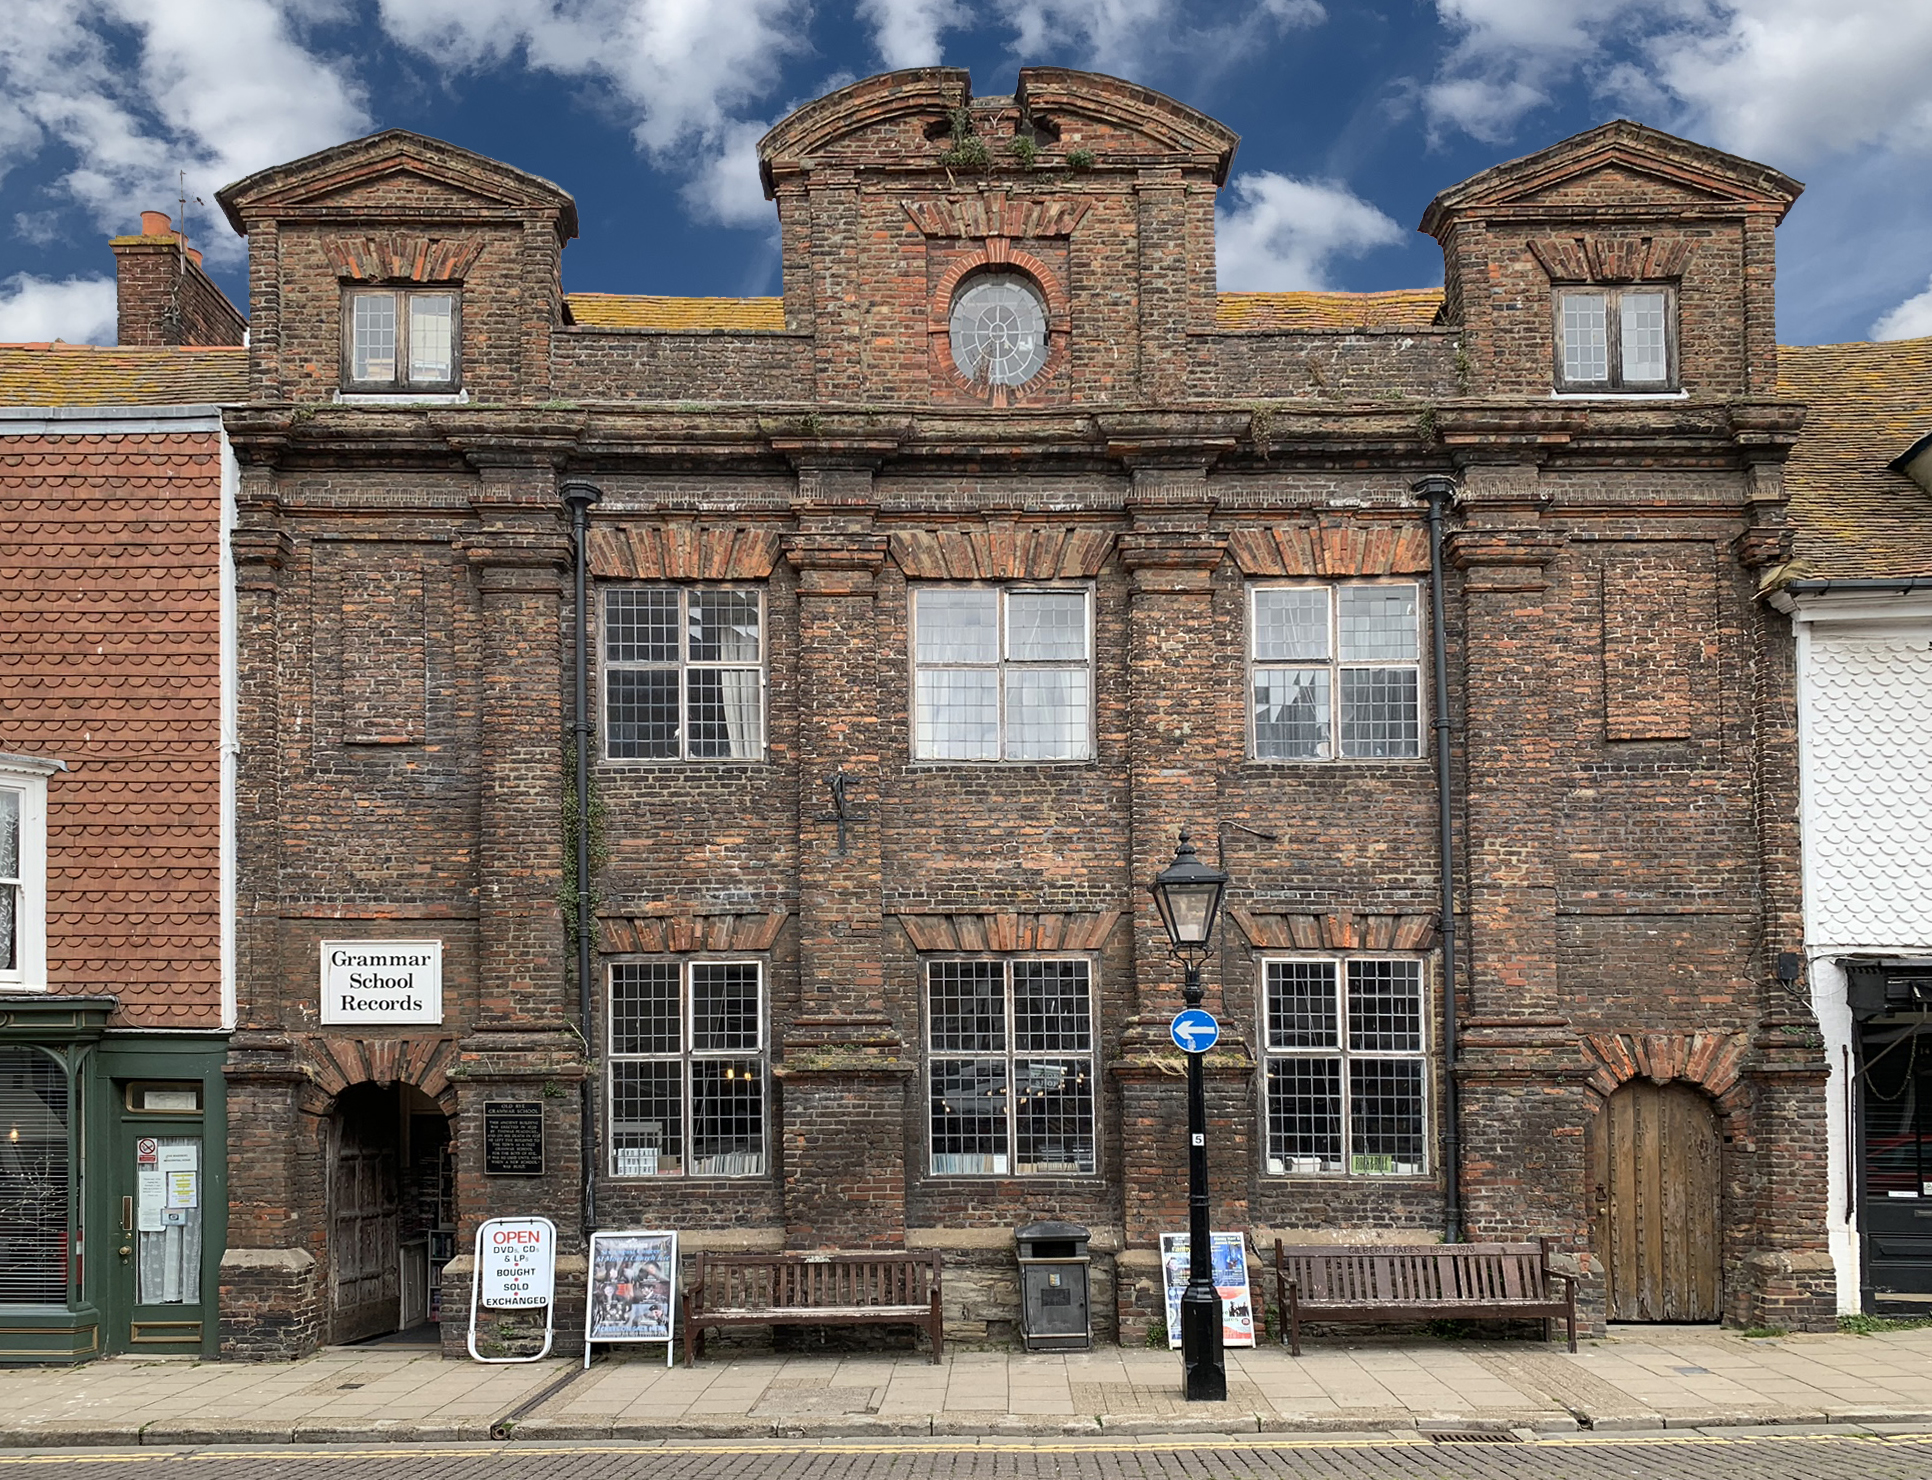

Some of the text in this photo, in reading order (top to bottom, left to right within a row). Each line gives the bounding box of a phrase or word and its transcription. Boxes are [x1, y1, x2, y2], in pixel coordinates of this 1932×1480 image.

[332, 950, 431, 966] Grammar
[350, 973, 414, 988] School
[340, 995, 422, 1010] Records
[1195, 1136, 1202, 1144] 5
[493, 1230, 540, 1244] OPEN
[1348, 1246, 1388, 1254] GILBERT
[497, 1268, 536, 1276] BOUGHT
[504, 1283, 529, 1291] SOLD
[486, 1296, 546, 1306] EXCHANGED
